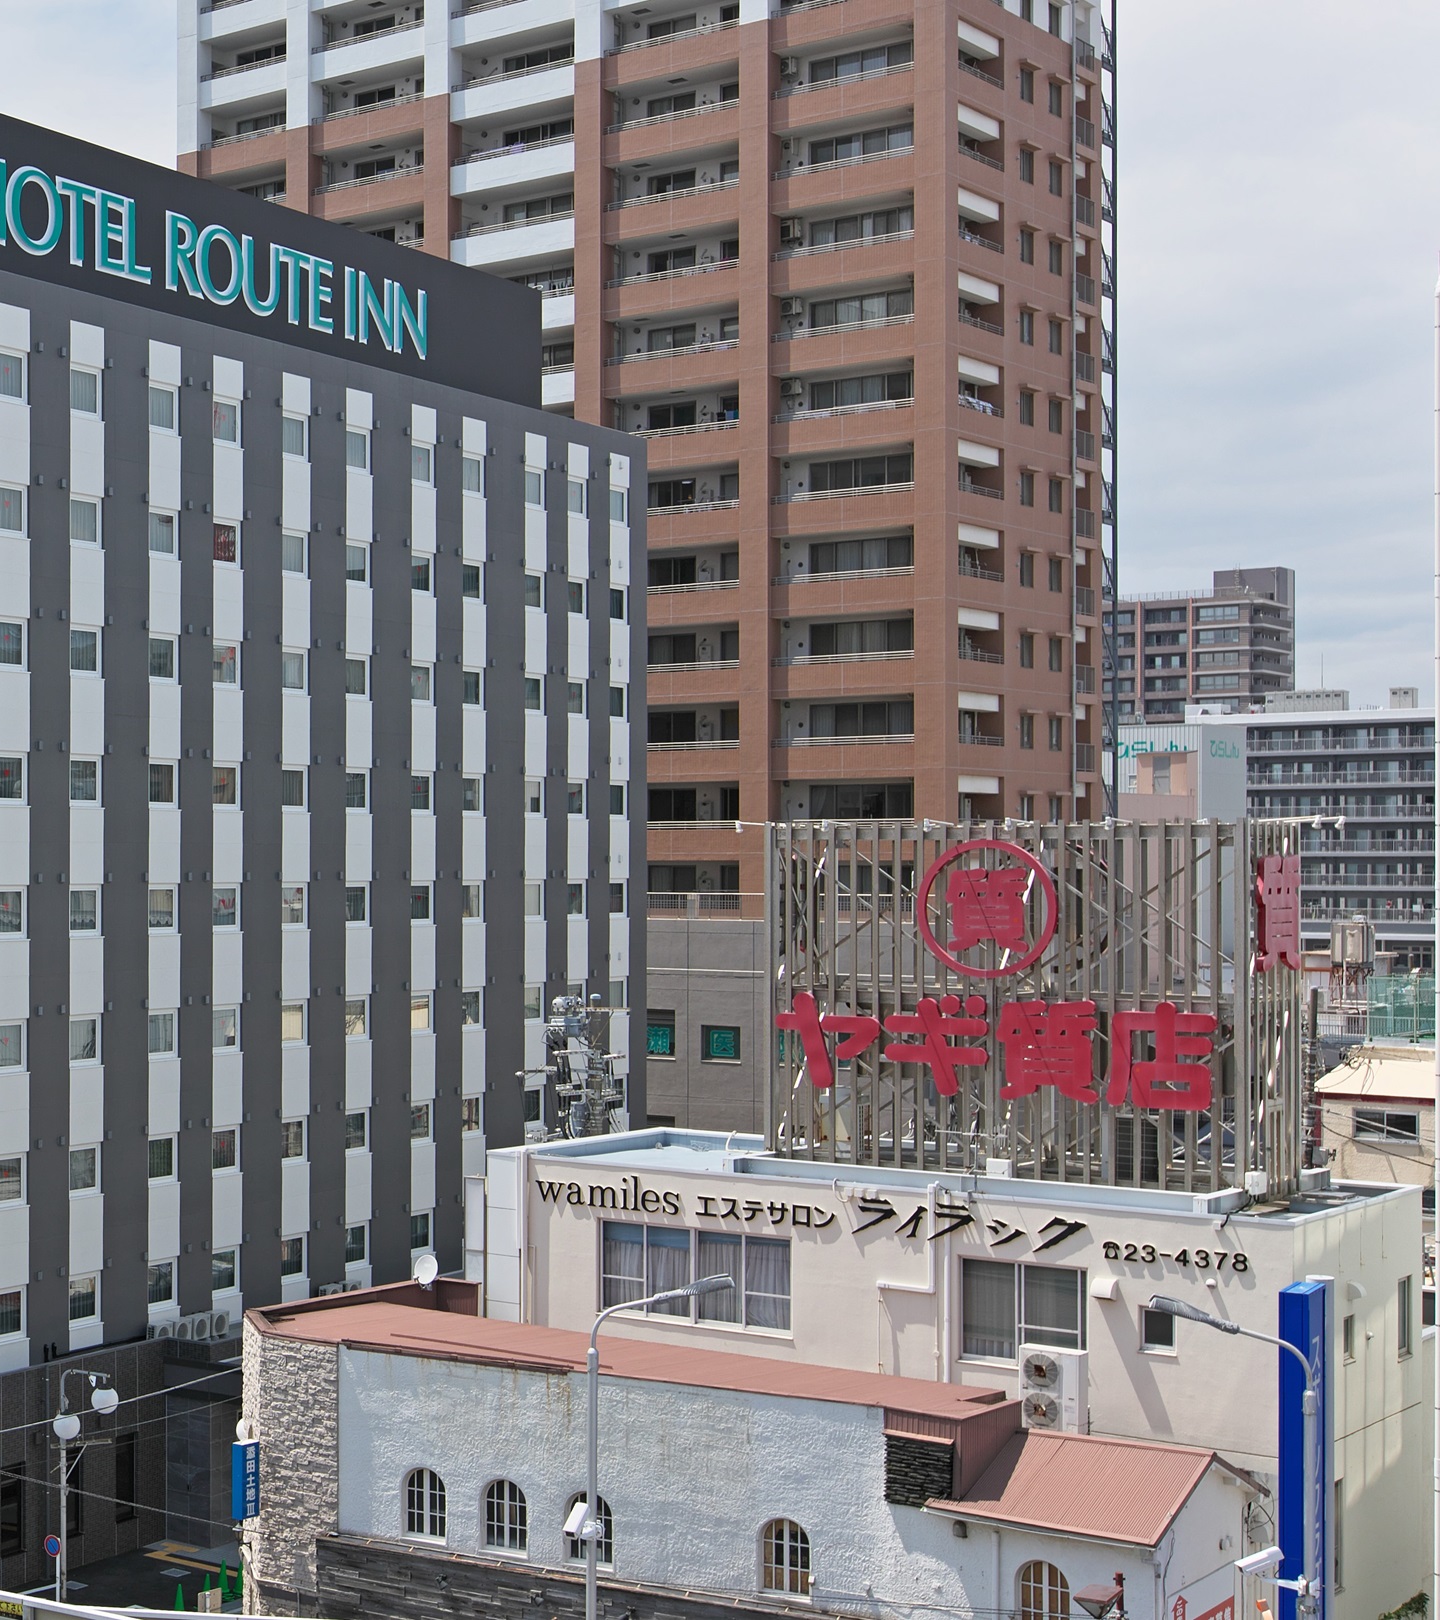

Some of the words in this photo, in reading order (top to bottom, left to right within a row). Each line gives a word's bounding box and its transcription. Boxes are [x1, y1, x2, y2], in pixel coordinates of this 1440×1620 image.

[165, 209, 334, 334] ROUTE
[344, 264, 427, 360] INN
[946, 867, 1029, 953] 質
[1257, 854, 1301, 973] 質
[775, 991, 1218, 1111] ヤギ質店
[535, 1175, 680, 1216] wamiles
[695, 1195, 836, 1229] エステサロン
[852, 1197, 1088, 1253] ライラック
[1123, 1242, 1249, 1273] 23-4378
